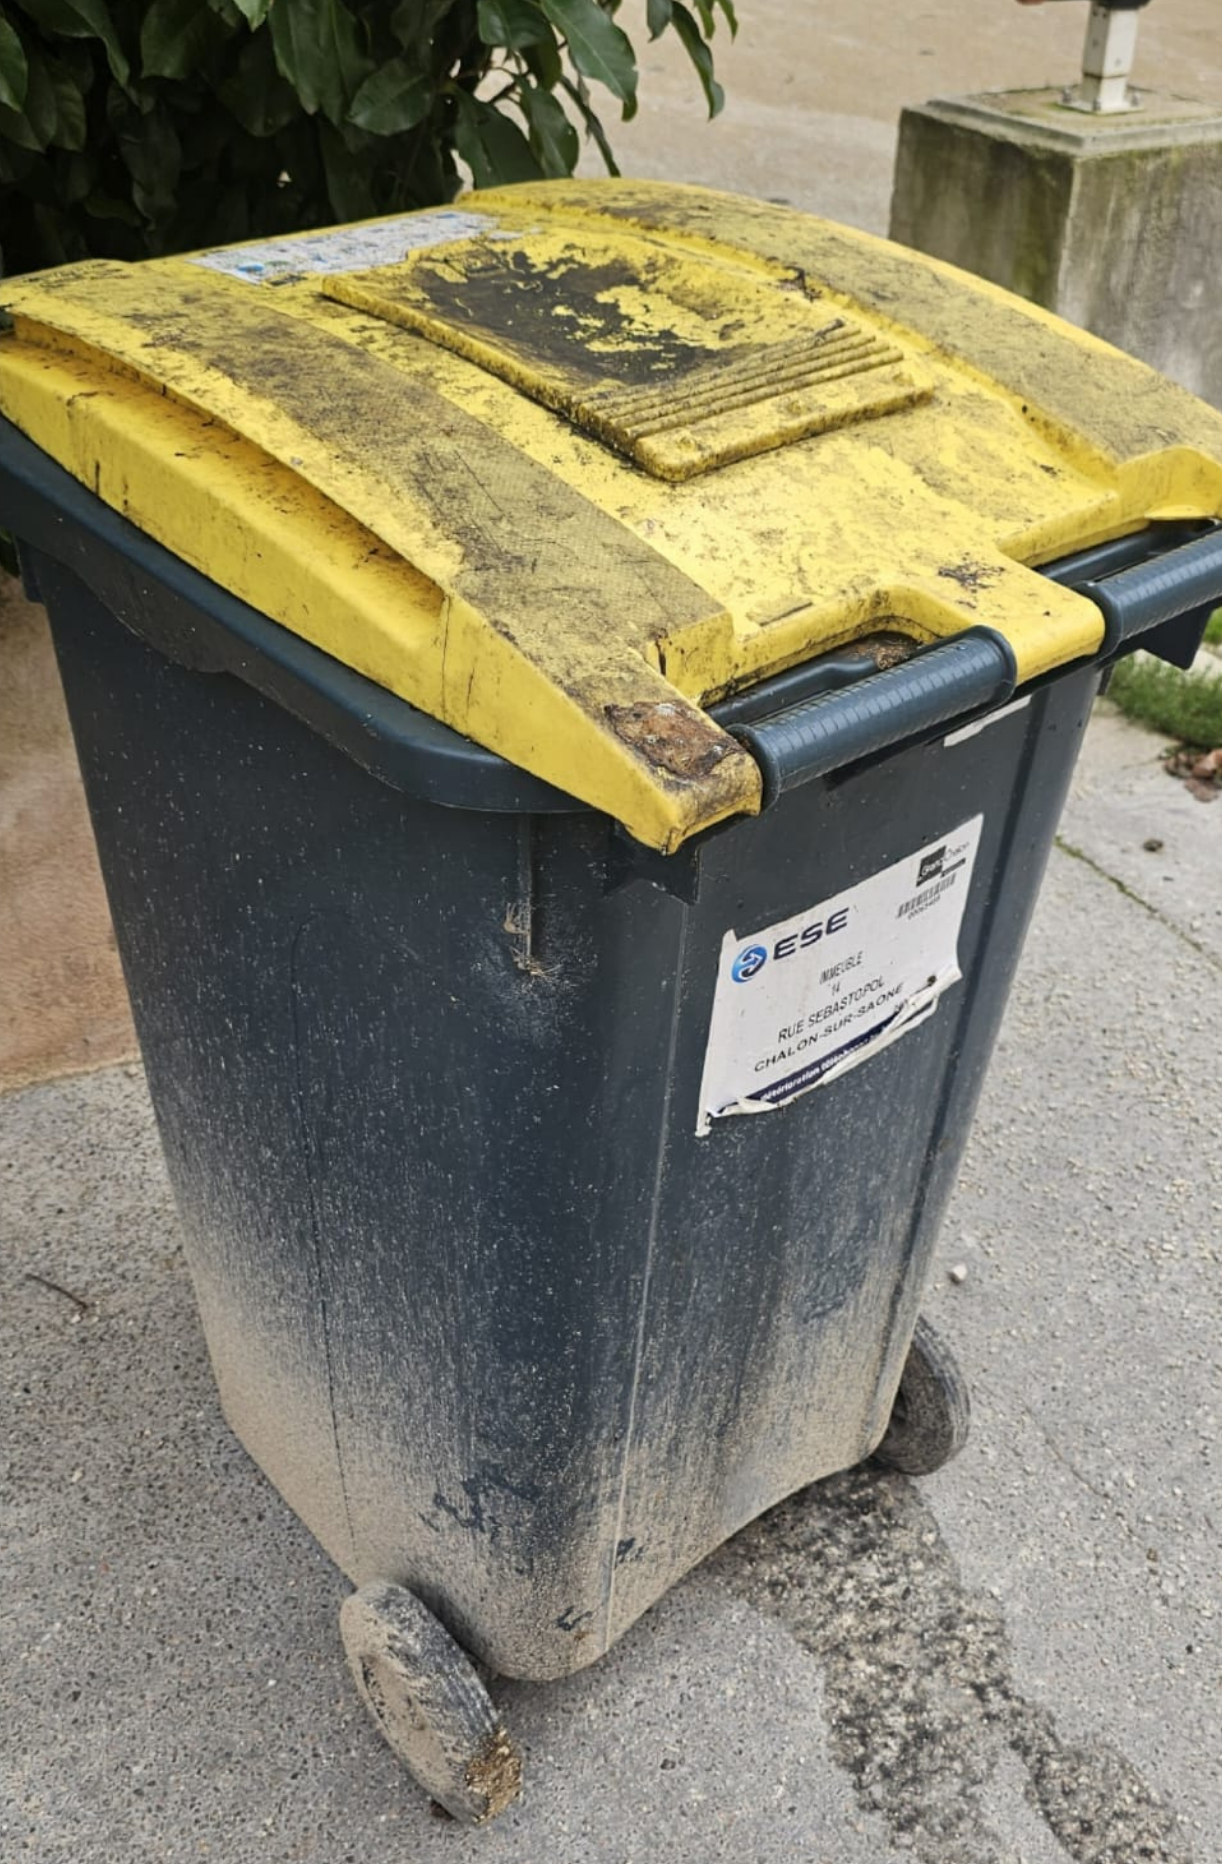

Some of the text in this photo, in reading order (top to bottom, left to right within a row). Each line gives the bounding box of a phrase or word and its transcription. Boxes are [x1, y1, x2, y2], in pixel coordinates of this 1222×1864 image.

[773, 907, 849, 961] ESE
[819, 950, 863, 985] IMMEUBLE
[754, 981, 904, 1072] CHALON-SUR-SAONE
[778, 975, 884, 1043] RUE SEBASTOPOL
